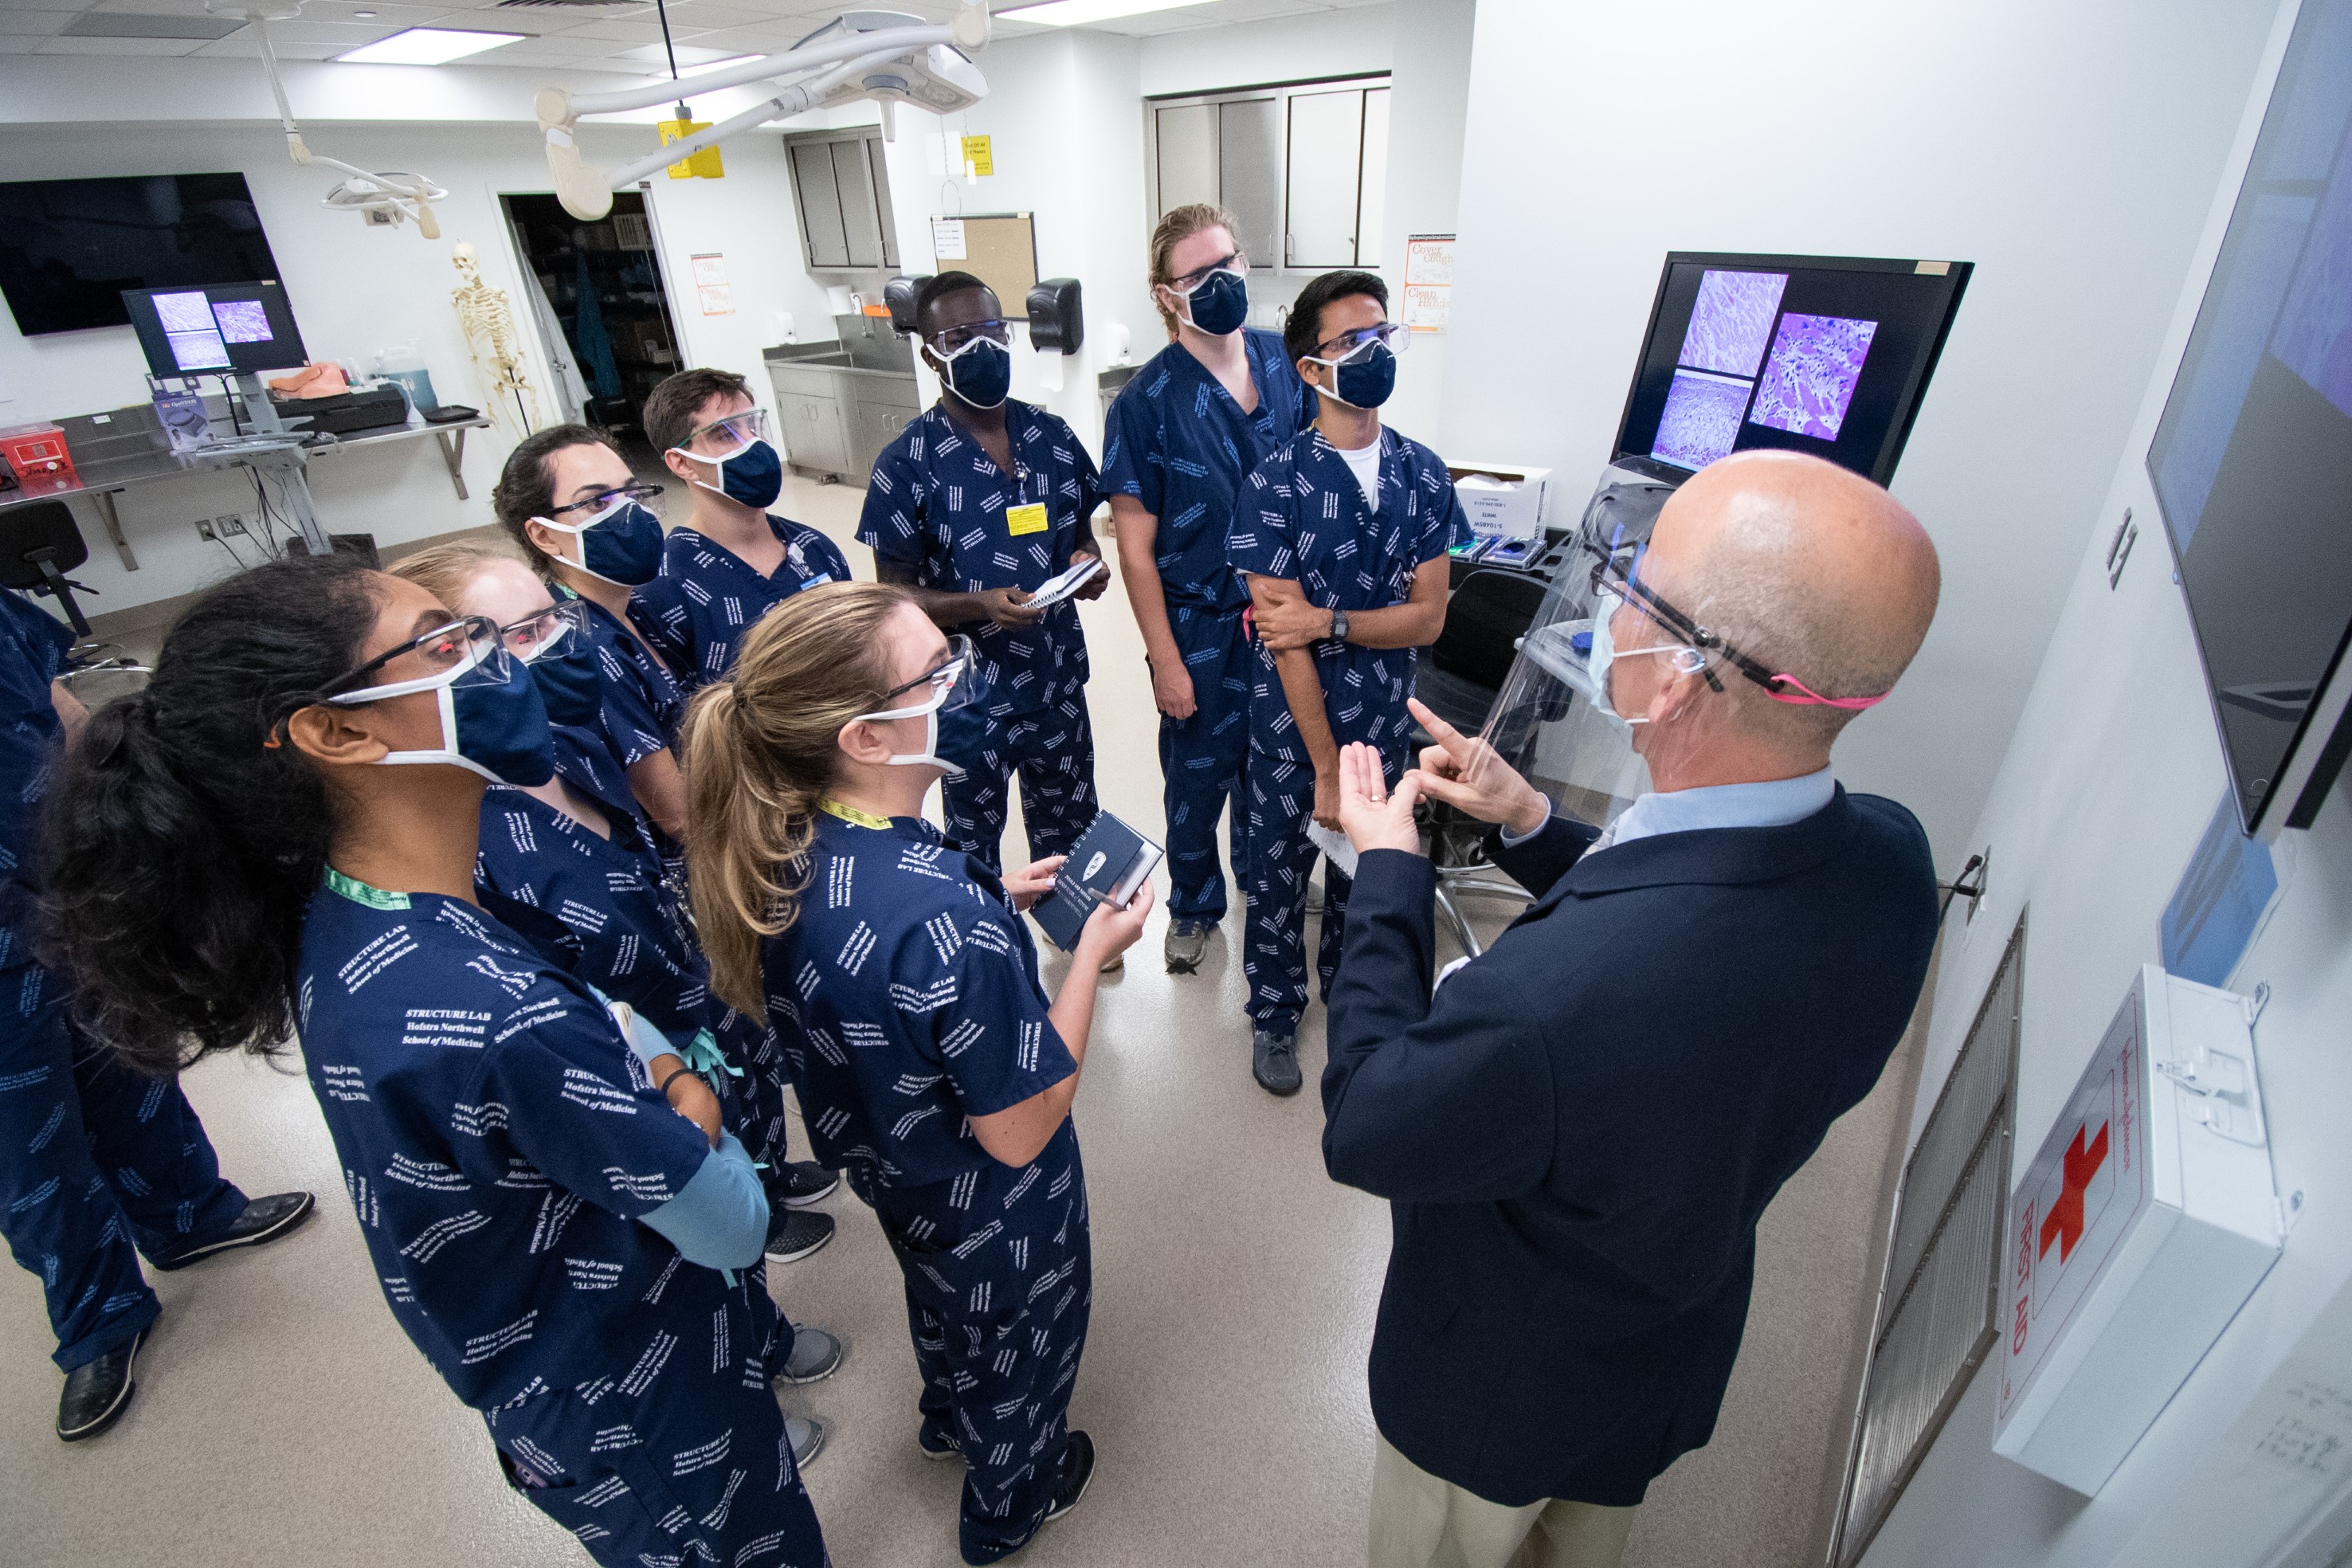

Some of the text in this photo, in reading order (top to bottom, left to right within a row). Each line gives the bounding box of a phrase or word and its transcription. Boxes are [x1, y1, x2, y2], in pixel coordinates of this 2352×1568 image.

[1413, 243, 1442, 254] Cover
[1423, 253, 1453, 265] Cough
[1409, 288, 1437, 298] Clean
[338, 935, 386, 978] STRUCTURE
[385, 925, 407, 939] LAB
[345, 934, 410, 985] Hofstra Northwell
[348, 971, 372, 994] School
[380, 943, 418, 968] Medicine
[405, 1009, 467, 1019] STRUCTURE
[468, 1011, 492, 1021] LAB
[406, 1021, 485, 1034] Hofstra Northwell
[495, 1021, 523, 1043] School
[532, 1009, 568, 1025] Medicine
[402, 1035, 484, 1048] School of Medicine
[564, 1081, 598, 1095] Hofstra
[561, 1091, 637, 1115] School of Medicine
[385, 1168, 472, 1191] School of Medicine
[399, 1217, 457, 1256] STRUCTURE
[597, 1263, 624, 1272] School
[2013, 1198, 2034, 1356] FIRST AID
[465, 1309, 538, 1347] STRUCTURE LAB
[466, 1342, 497, 1356] Hofstra
[461, 1352, 490, 1364] School
[617, 1347, 653, 1394] STRUCTURE
[673, 1438, 720, 1460] STRUCTURE
[675, 1456, 702, 1468] Hofstra
[672, 1465, 696, 1476] School
